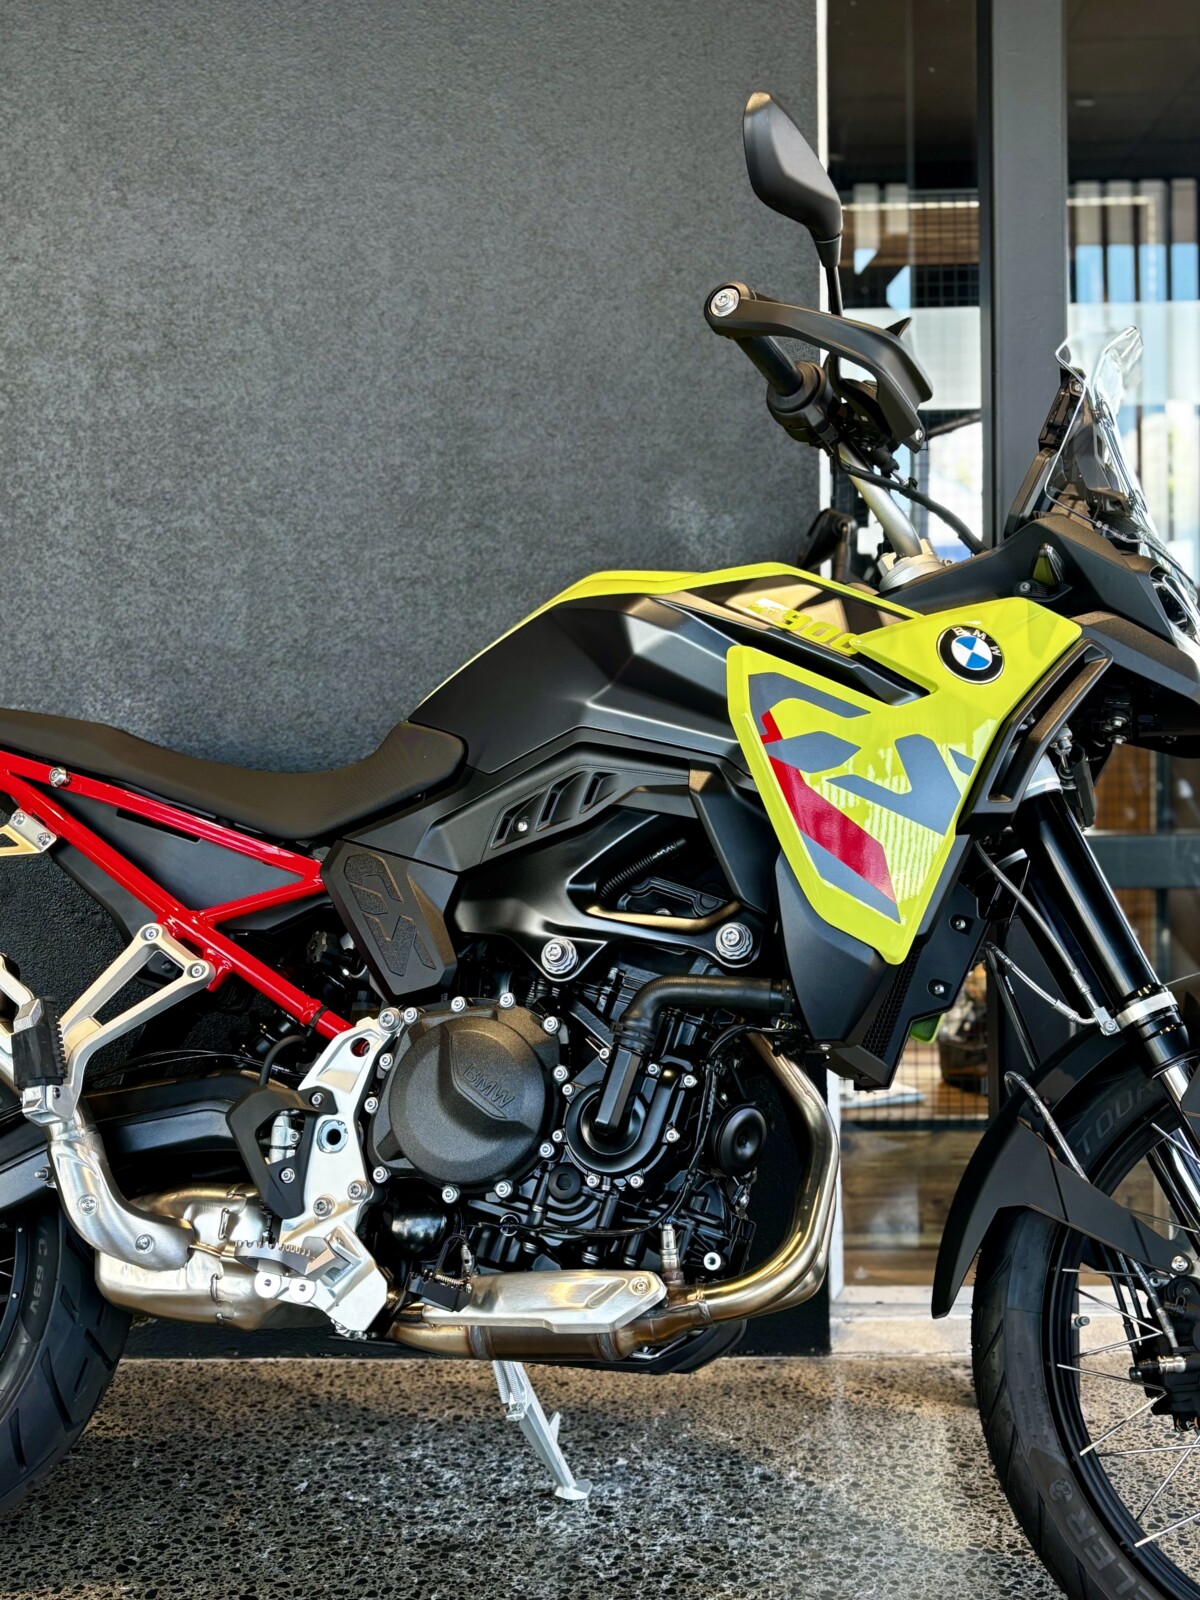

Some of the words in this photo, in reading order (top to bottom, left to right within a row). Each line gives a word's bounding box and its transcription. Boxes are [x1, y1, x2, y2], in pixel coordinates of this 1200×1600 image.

[951, 626, 1002, 657] BMW
[463, 1063, 516, 1109] BMW
[29, 1265, 44, 1315] 69V
